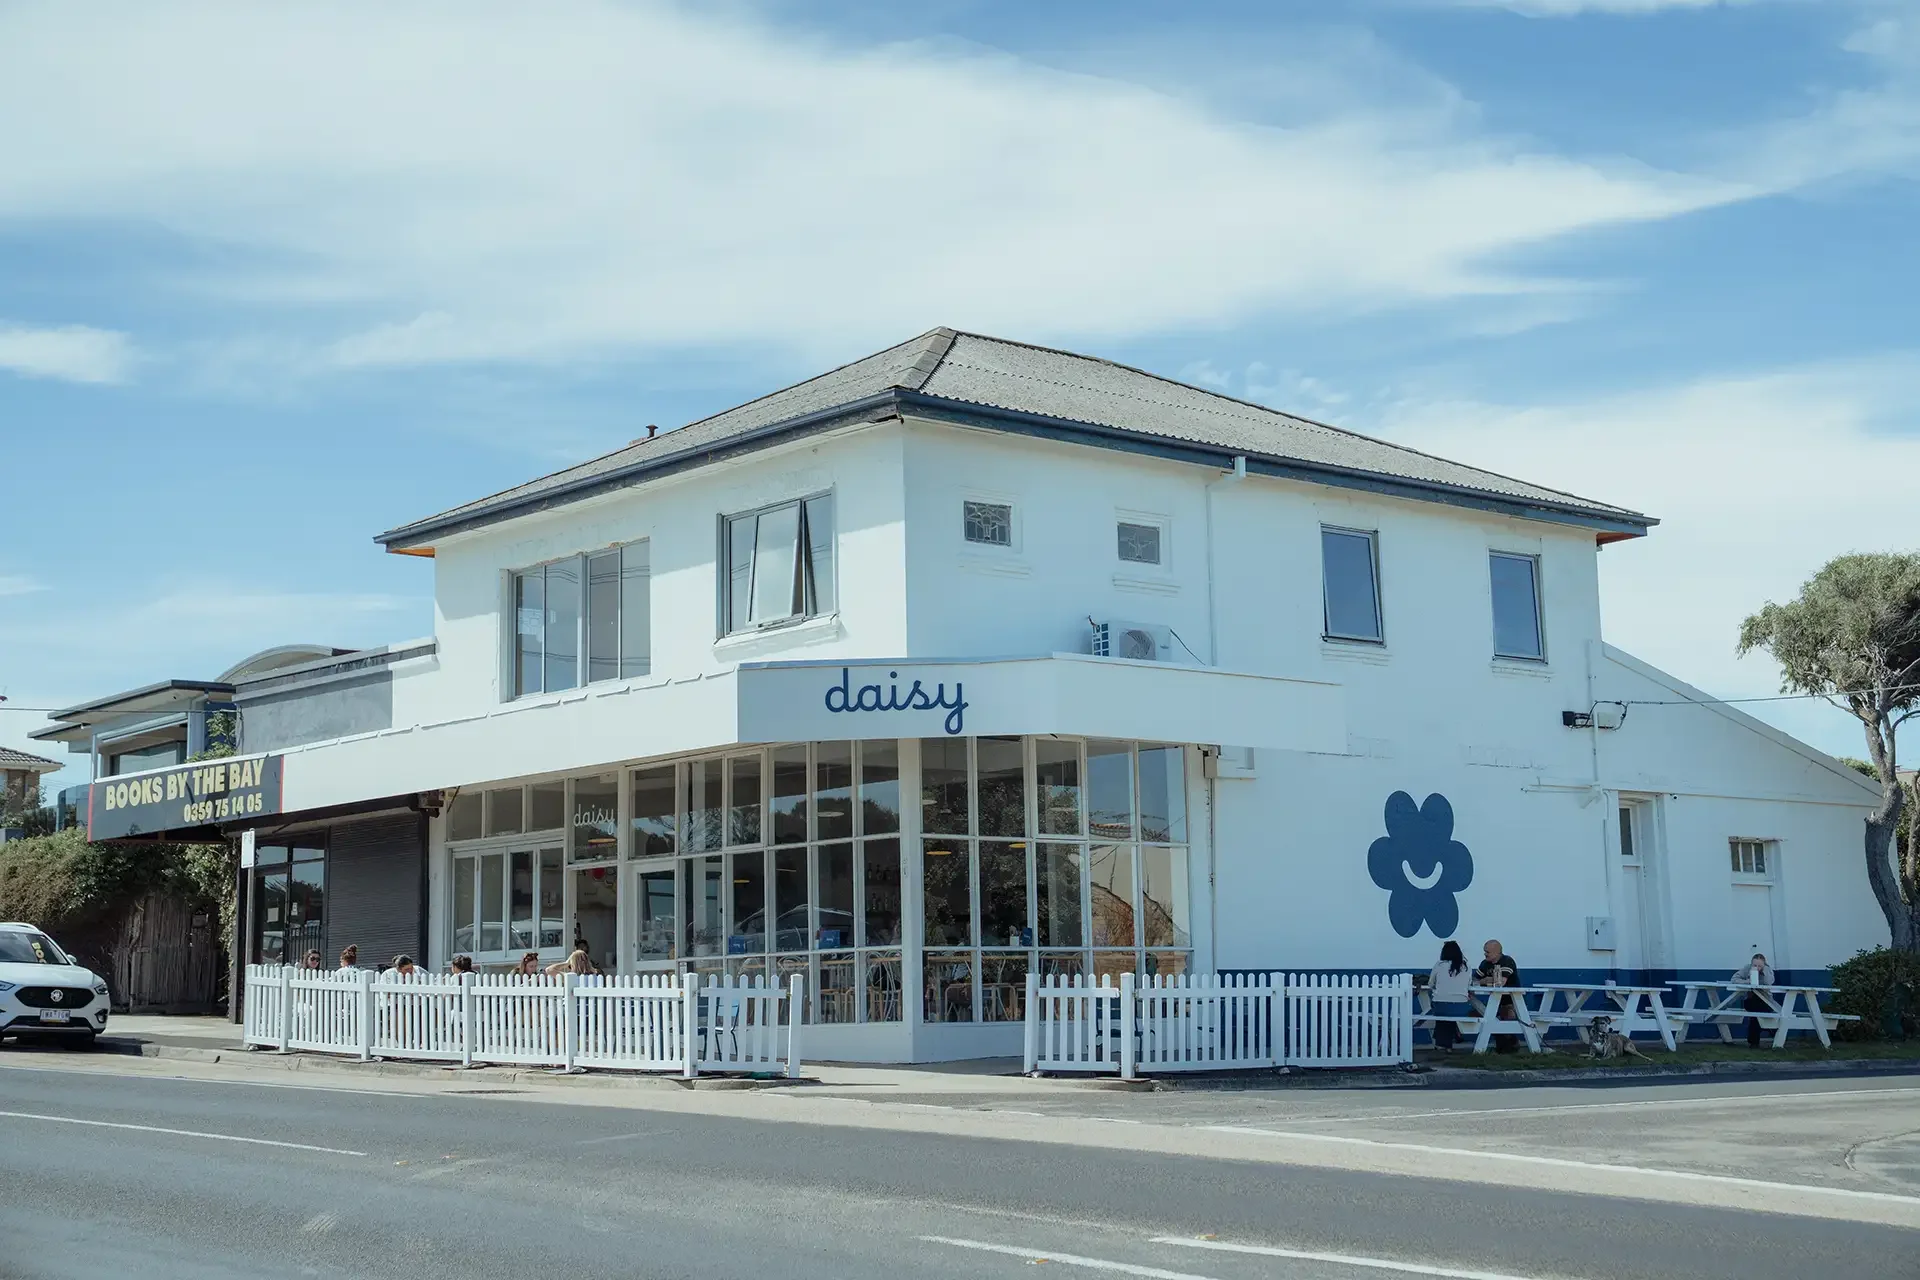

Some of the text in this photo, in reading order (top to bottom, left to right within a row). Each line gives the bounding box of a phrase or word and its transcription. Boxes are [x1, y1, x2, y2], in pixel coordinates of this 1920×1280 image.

[825, 667, 969, 735] daisy
[105, 758, 265, 811] BOOKS BY THE BAY
[183, 792, 263, 823] 0359 75 14 05
[573, 803, 615, 835] daisy
